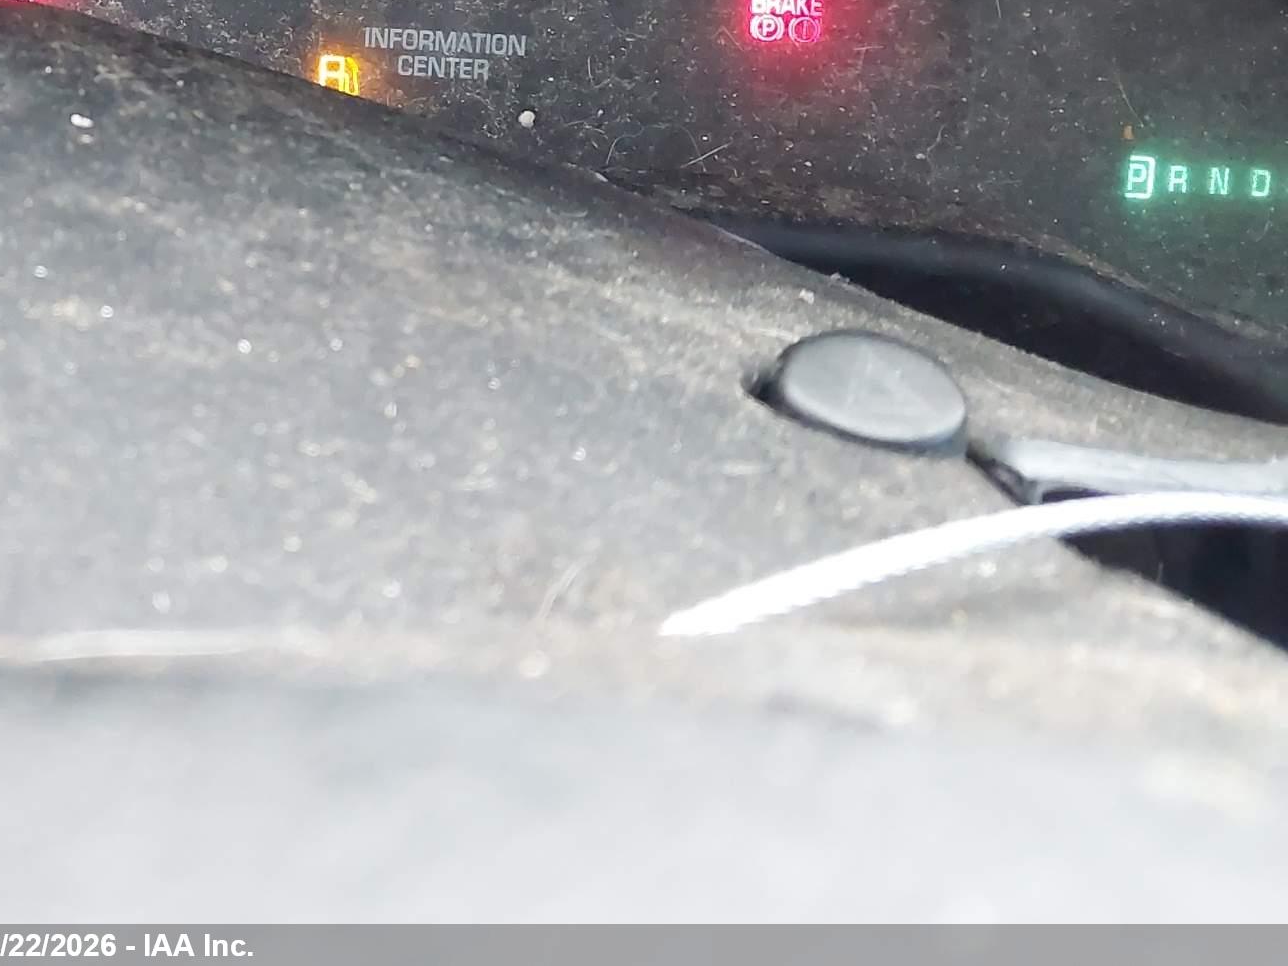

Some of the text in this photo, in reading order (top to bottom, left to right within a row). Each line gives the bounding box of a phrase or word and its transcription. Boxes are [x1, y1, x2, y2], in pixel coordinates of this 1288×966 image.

[364, 27, 527, 57] INFORMATION
[398, 55, 490, 81] CENTER
[1168, 165, 1188, 194] R
[1208, 166, 1230, 195] N
[1251, 168, 1272, 197] D
